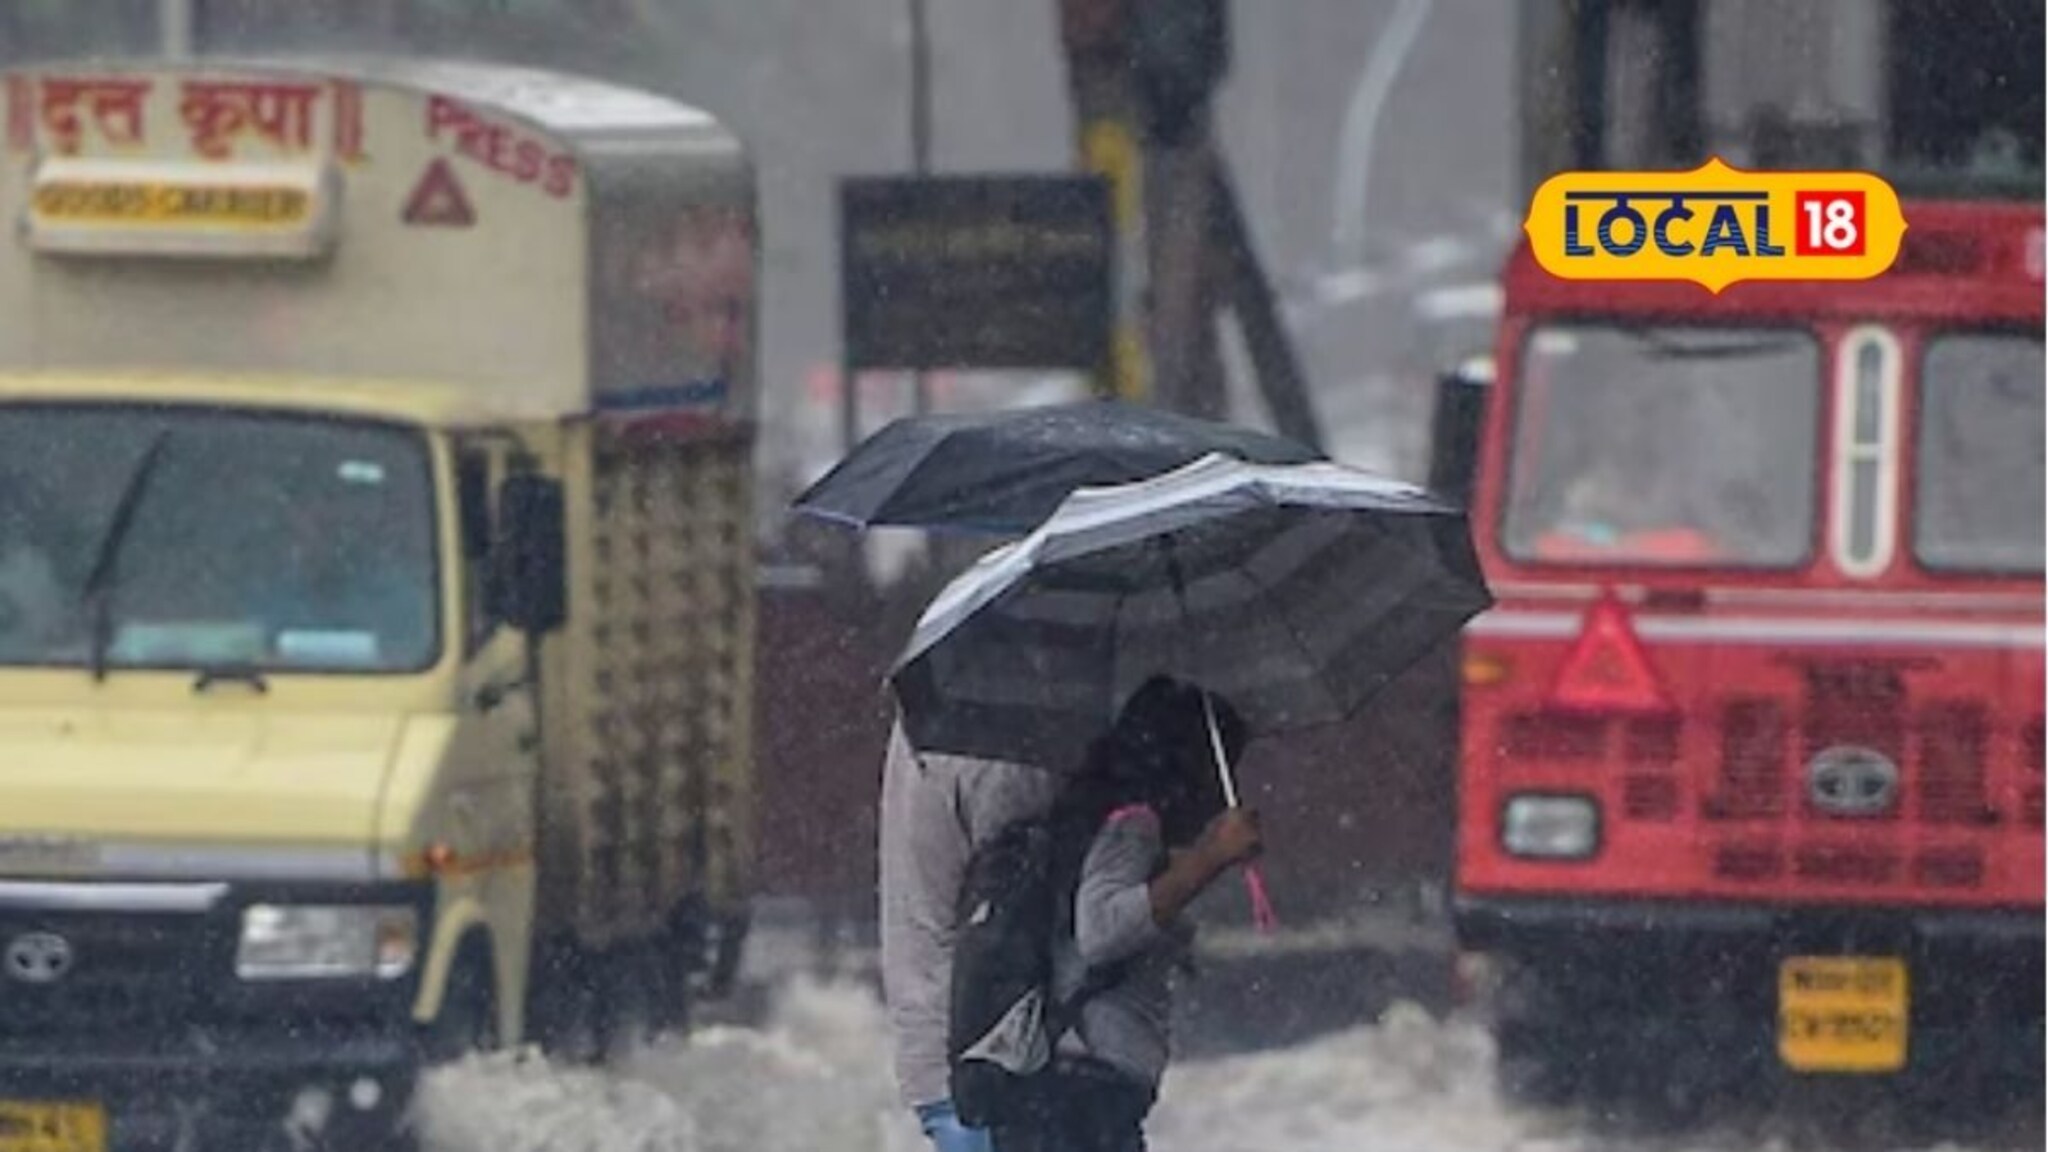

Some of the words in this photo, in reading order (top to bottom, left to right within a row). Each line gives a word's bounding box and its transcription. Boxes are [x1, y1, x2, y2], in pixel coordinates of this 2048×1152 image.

[424, 93, 577, 199] PRESS
[36, 183, 148, 218] GOODS
[160, 185, 309, 223] CARRIER
